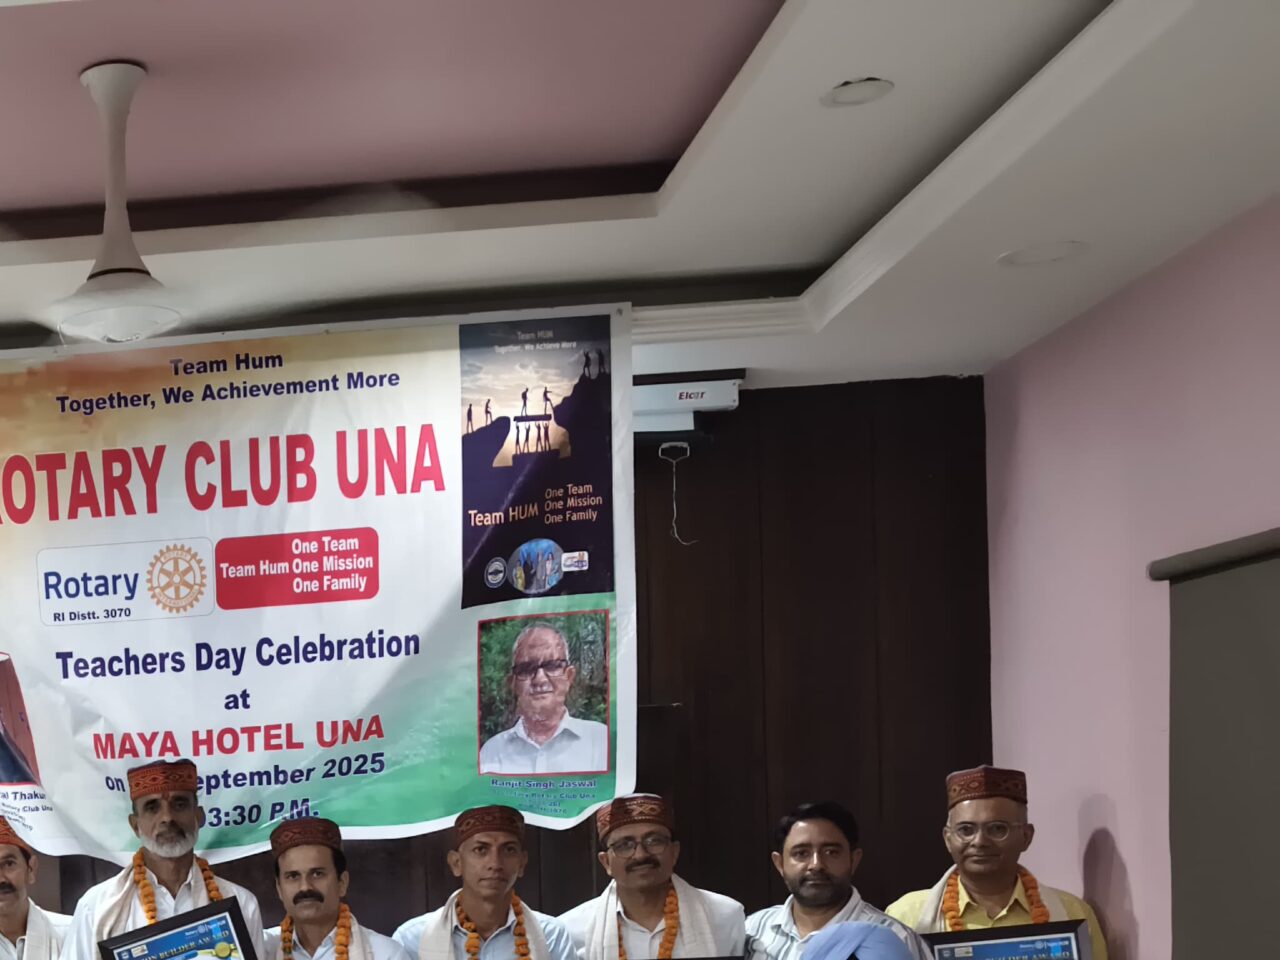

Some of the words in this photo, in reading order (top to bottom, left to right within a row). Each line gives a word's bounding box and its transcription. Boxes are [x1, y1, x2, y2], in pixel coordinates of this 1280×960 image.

[170, 358, 227, 376] Team
[235, 353, 283, 371] Hum
[56, 391, 156, 415] Together,
[162, 387, 194, 404] We
[201, 373, 339, 401] Achievement
[347, 370, 400, 389] More
[185, 433, 317, 511] CLUB
[336, 423, 446, 499] UNA
[545, 488, 564, 499] One
[567, 483, 593, 495] Team
[468, 510, 504, 527] Team
[509, 502, 539, 522] HUM
[544, 500, 564, 511] One
[566, 495, 603, 508] Mission
[544, 513, 563, 525] One
[566, 509, 598, 522] Family
[292, 538, 318, 554] One
[322, 536, 359, 552] Team
[220, 562, 256, 578] Team
[259, 560, 289, 575] Hum
[292, 558, 319, 574] One
[323, 554, 373, 571] Mission
[43, 571, 139, 600] Rotary
[293, 578, 319, 593] One
[323, 574, 367, 592] Family
[53, 612, 65, 622] RI
[69, 611, 100, 621] Distt.
[103, 607, 131, 619] 3070
[56, 647, 186, 679] Teachers
[195, 642, 247, 676] Day
[255, 630, 420, 666] Celebration
[223, 688, 250, 710] at
[93, 730, 180, 760] MAYA
[191, 722, 304, 758] HOTEL
[315, 714, 385, 748] UNA
[105, 775, 125, 793] on
[196, 765, 316, 795] eptember
[322, 751, 385, 779] 2025
[526, 781, 554, 789] Singh
[559, 780, 596, 788] Jaswal
[11, 790, 46, 800] Thaku
[159, 942, 196, 959] BUILDER
[198, 930, 229, 946] AWARD
